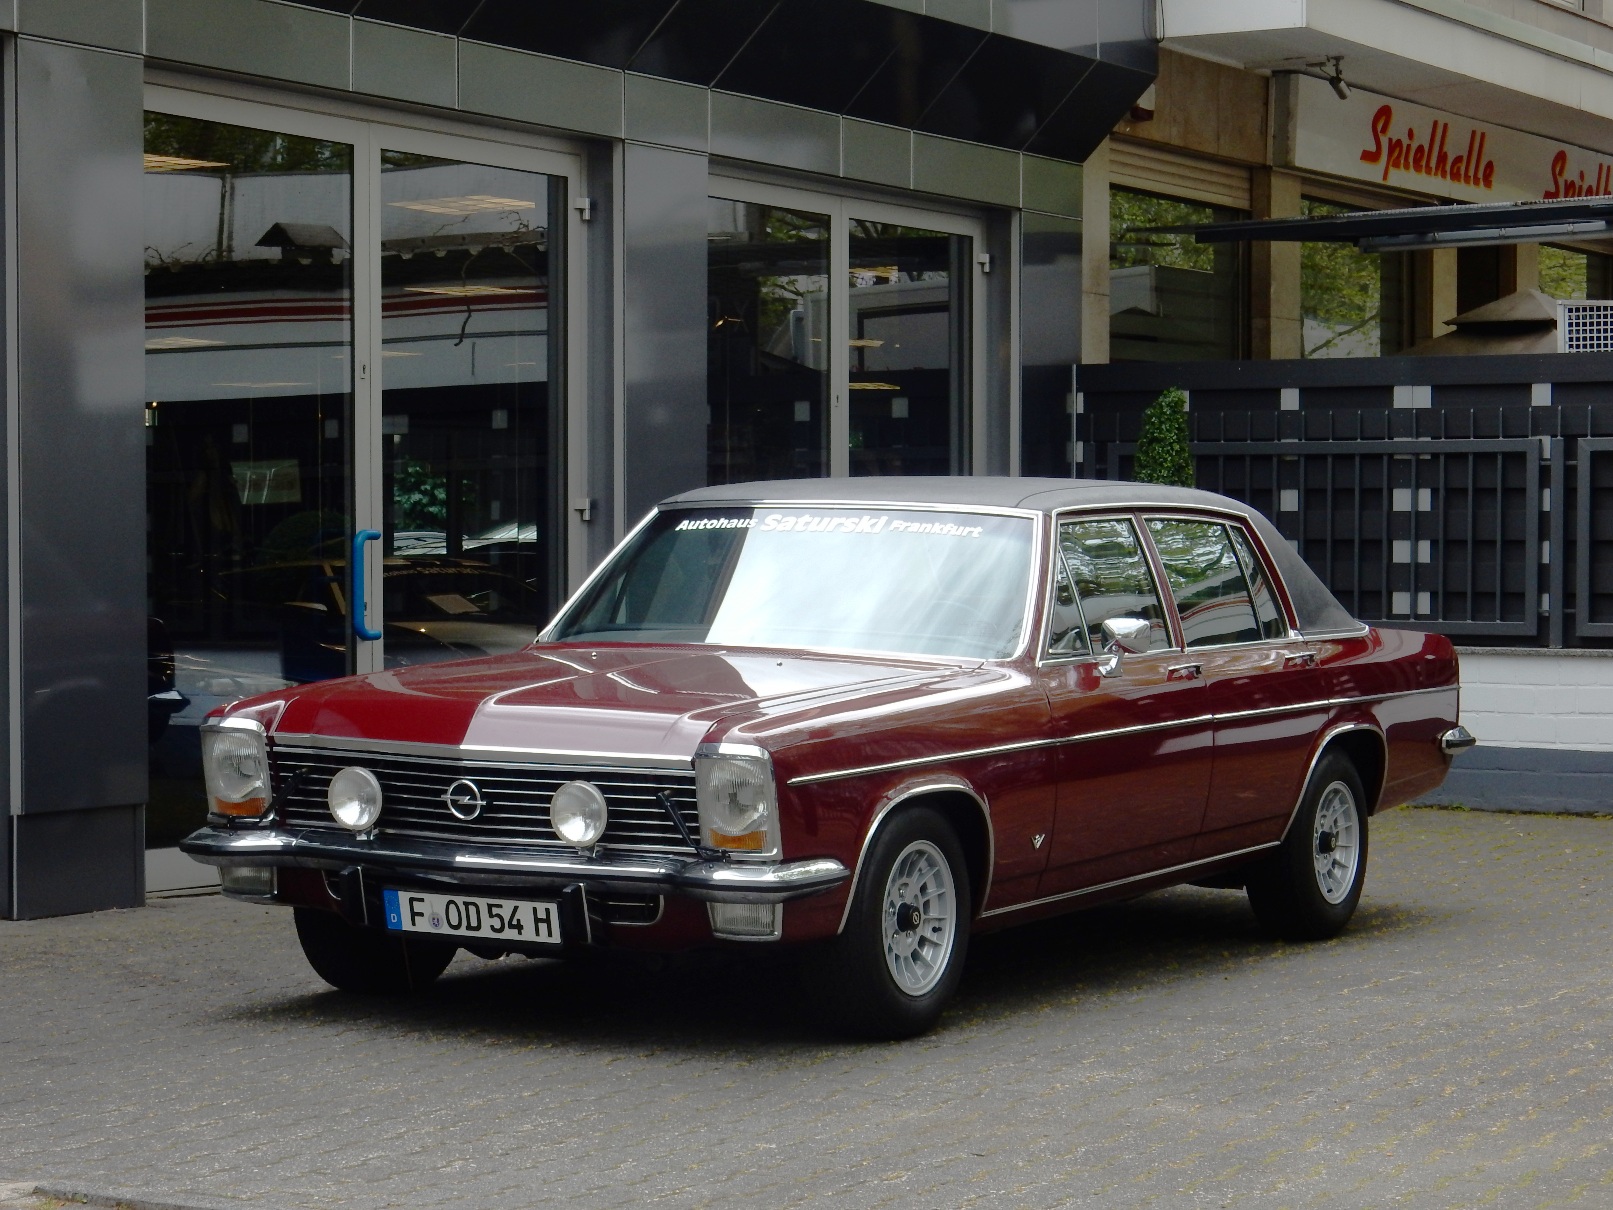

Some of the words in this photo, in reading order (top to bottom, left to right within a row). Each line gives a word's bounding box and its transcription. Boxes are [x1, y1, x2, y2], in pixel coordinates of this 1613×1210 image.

[1360, 104, 1494, 189] Spielhalle
[675, 517, 757, 532] Autohaus
[760, 513, 889, 534] Saturski
[889, 519, 983, 538] Frankfurt
[391, 913, 397, 923] D
[408, 896, 425, 927] F
[532, 906, 553, 938] H
